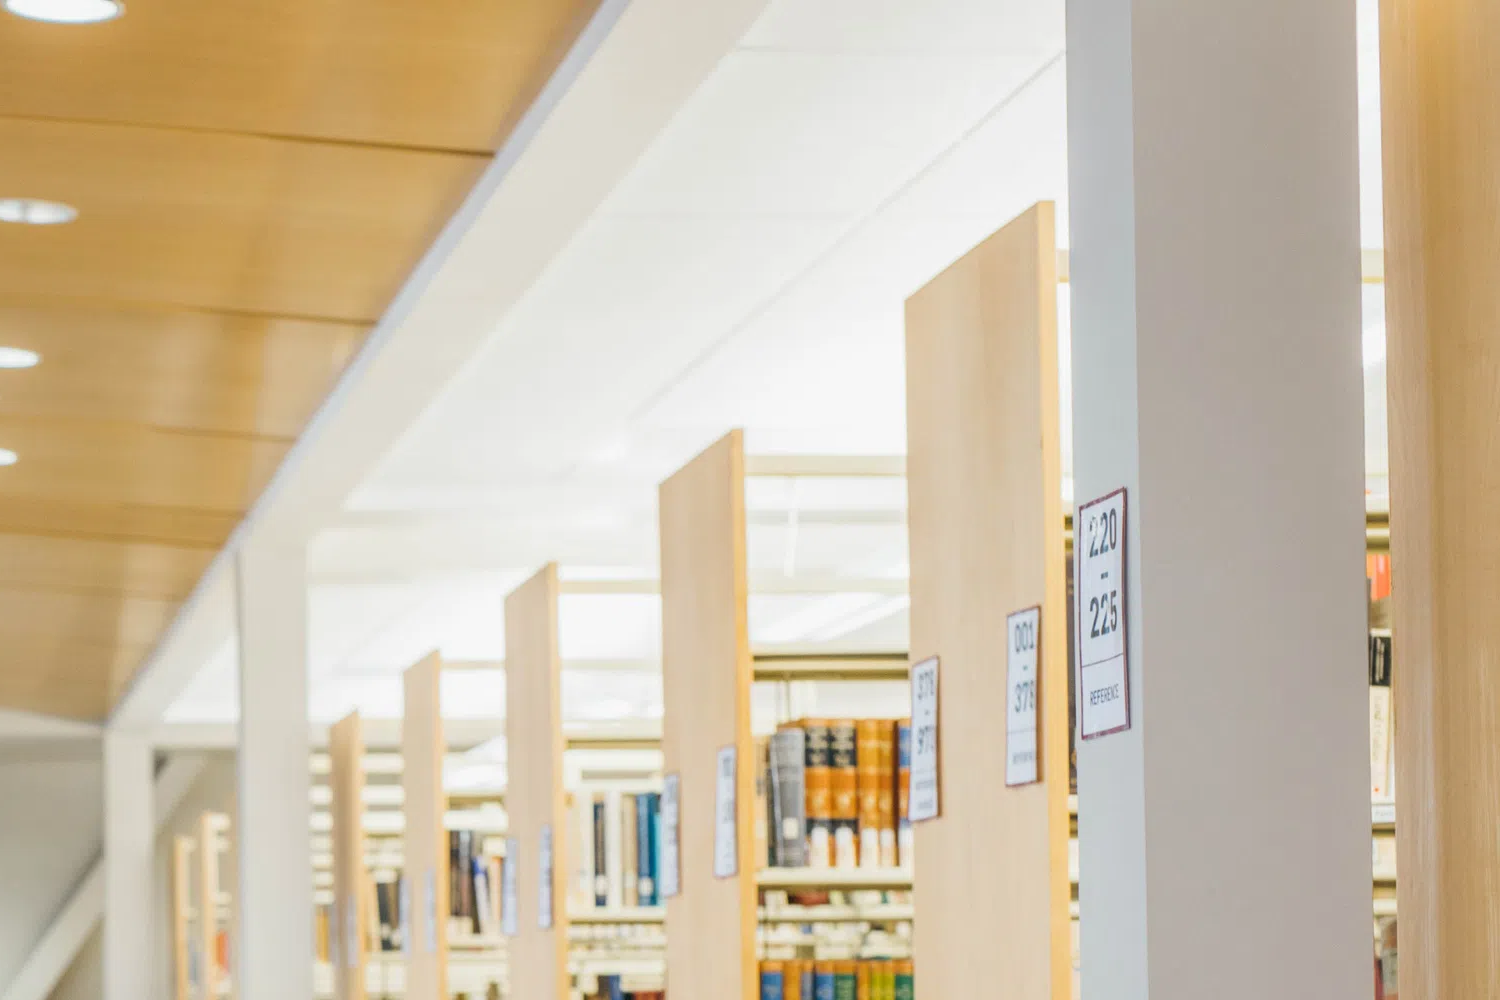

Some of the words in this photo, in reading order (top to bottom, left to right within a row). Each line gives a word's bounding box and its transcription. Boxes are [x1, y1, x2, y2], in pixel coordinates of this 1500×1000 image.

[1088, 508, 1118, 558] 220
[1089, 590, 1118, 639] 225
[1014, 621, 1036, 654] 001
[1089, 683, 1120, 706] REFERENCE
